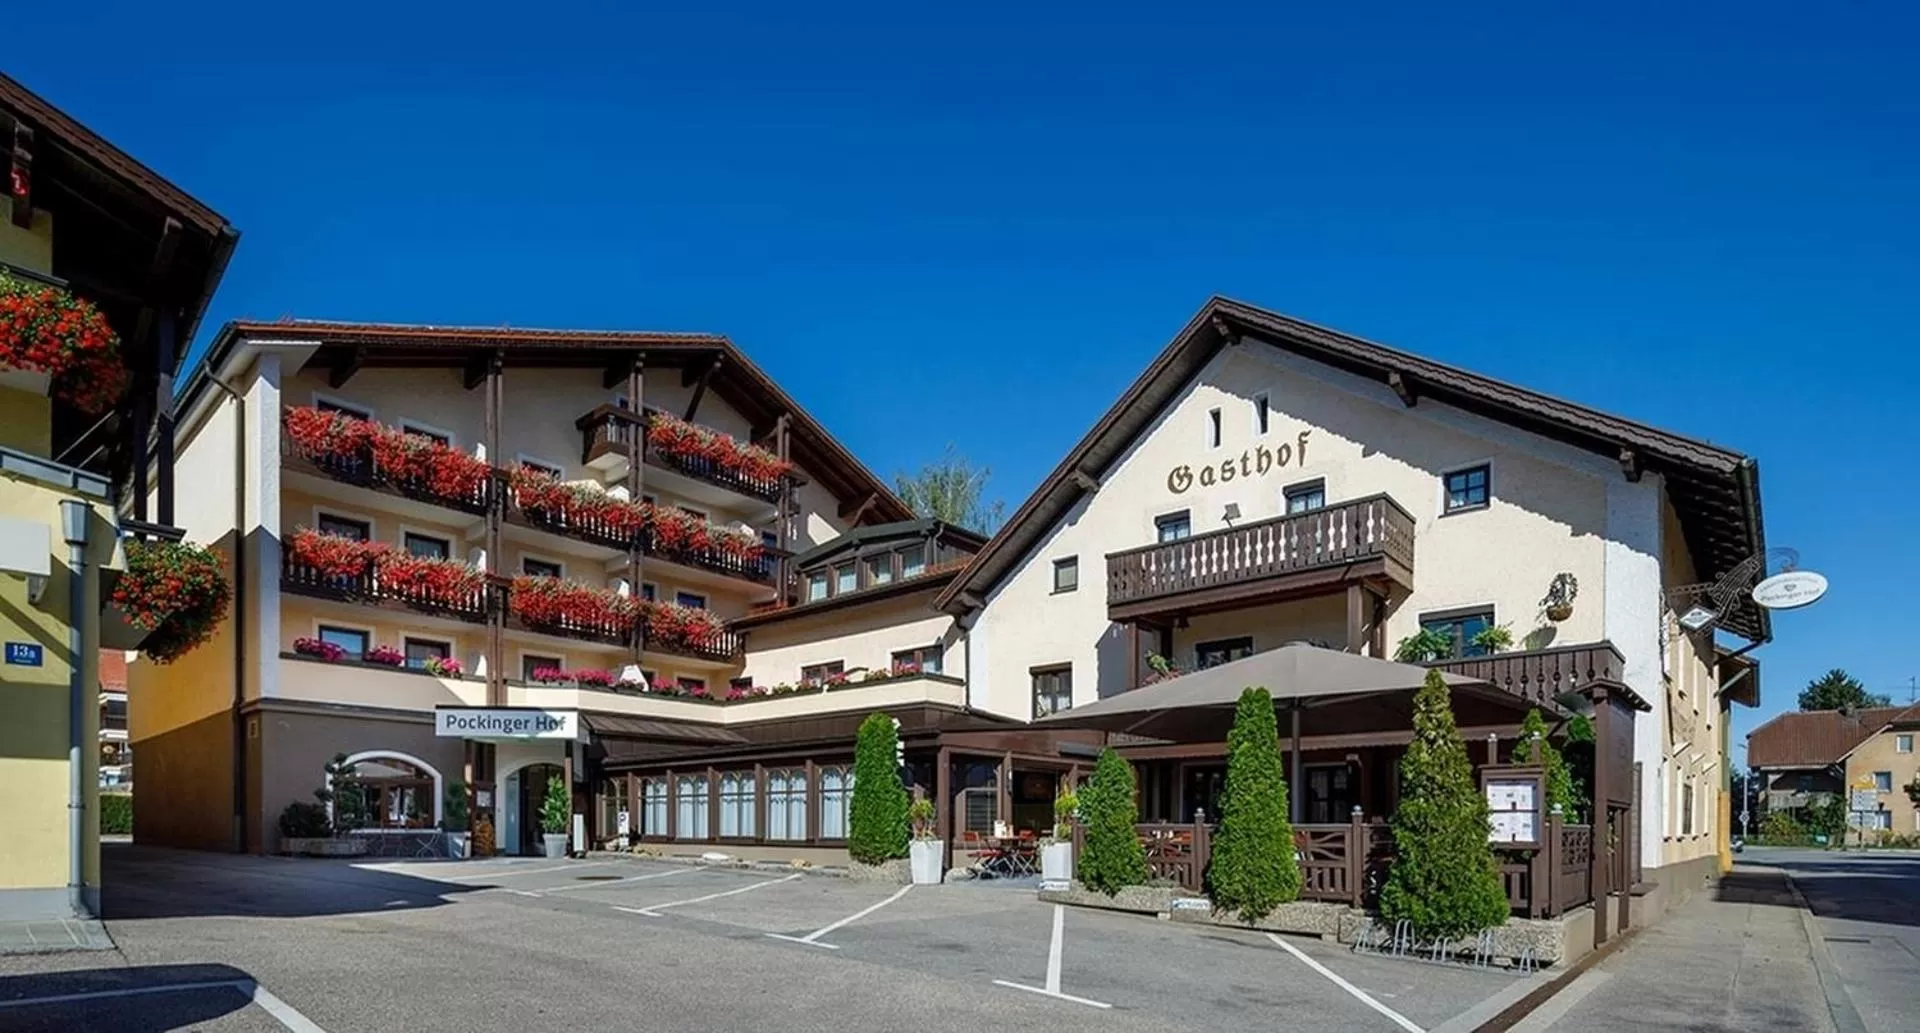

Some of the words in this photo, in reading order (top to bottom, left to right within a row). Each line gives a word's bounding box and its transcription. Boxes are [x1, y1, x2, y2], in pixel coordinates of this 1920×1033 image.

[1167, 430, 1311, 494] Gasthof
[446, 714, 531, 733] Pockinger
[535, 715, 566, 731] Hof
